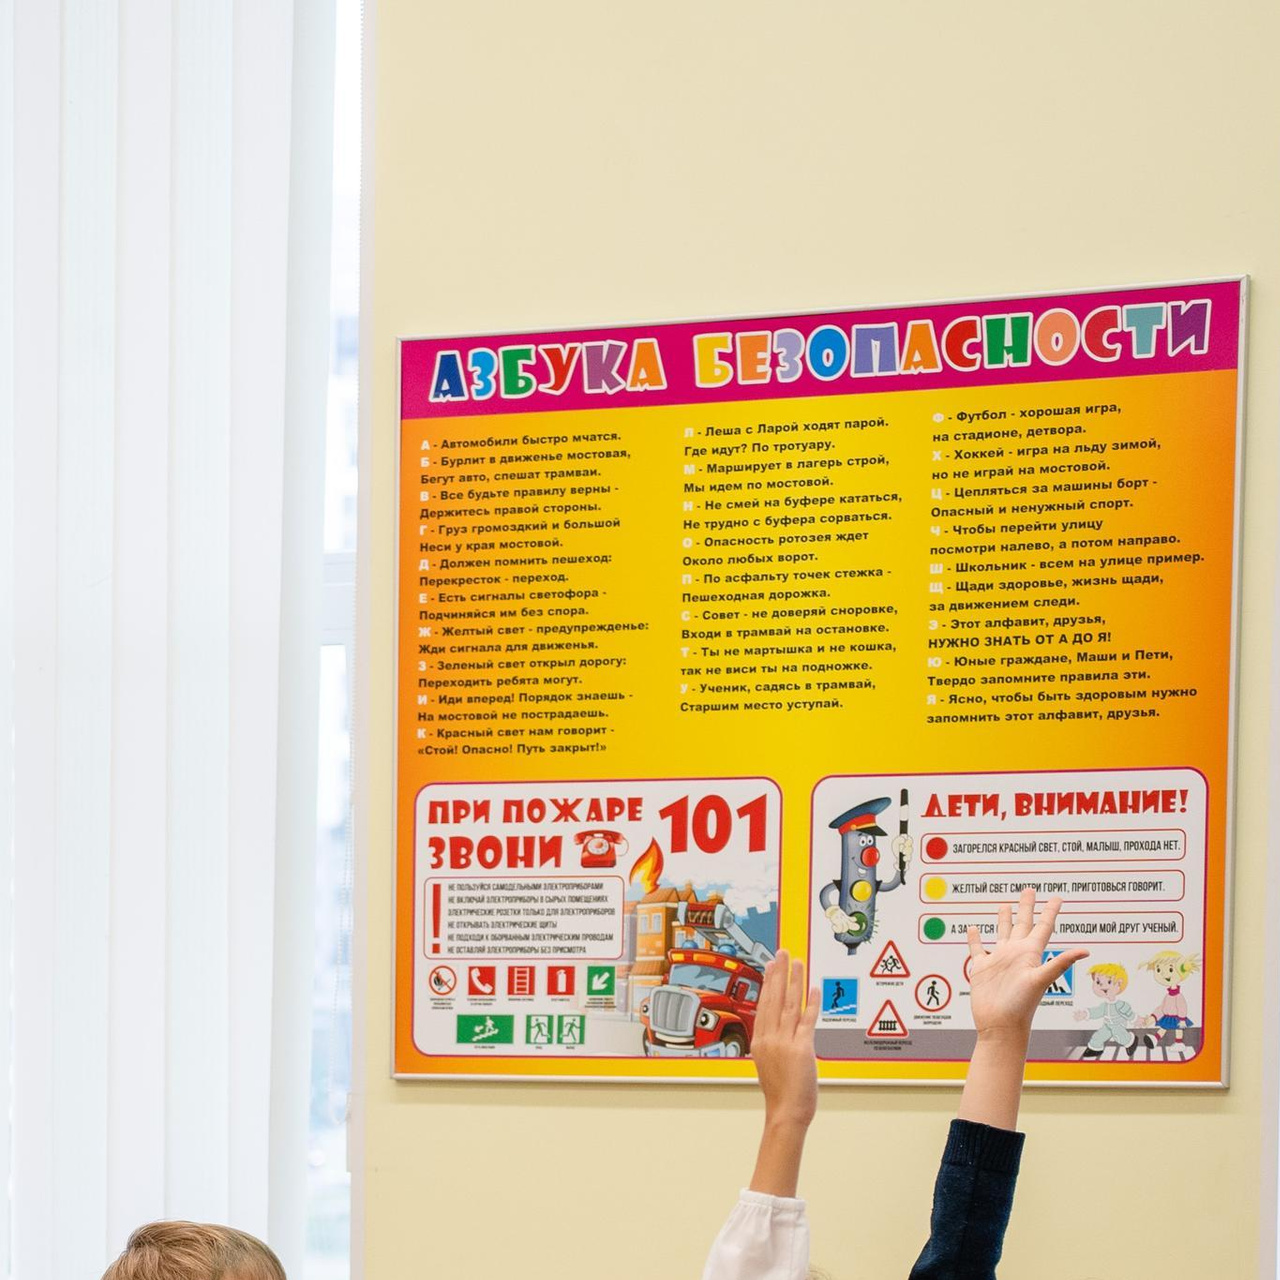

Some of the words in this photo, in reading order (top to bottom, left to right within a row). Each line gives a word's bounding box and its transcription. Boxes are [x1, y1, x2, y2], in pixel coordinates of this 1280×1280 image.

[429, 338, 667, 401] АЗБУКА
[694, 299, 1213, 387] БЕЗОПАСНОСТИ
[932, 433, 949, 442] на
[953, 429, 1022, 441] стадионе,
[1025, 425, 1086, 438] детвора.
[684, 445, 707, 457] Где
[711, 442, 747, 456] идут?
[751, 442, 769, 452] По
[772, 440, 835, 453] тротуару.
[420, 474, 455, 485] Бегут
[458, 473, 490, 482] авто,
[493, 471, 541, 481] спешат
[543, 468, 601, 480] трамваи.
[931, 471, 948, 480] но
[952, 470, 969, 478] не
[973, 465, 1013, 479] играй
[1018, 466, 1035, 475] на
[1039, 460, 1110, 474] мостовой.
[683, 482, 704, 492] Мы
[709, 482, 742, 492] идем
[746, 481, 762, 490] по
[766, 475, 833, 489] мостовой.
[419, 508, 490, 520] Держитесь
[494, 503, 539, 517] правой
[542, 503, 601, 514] стороны.
[930, 504, 994, 517] Опасный
[998, 506, 1006, 514] и
[1011, 499, 1085, 515] ненужный
[1089, 499, 1133, 510] спорт.
[683, 519, 700, 529] Не
[704, 519, 749, 531] трудно
[752, 518, 760, 526] с
[764, 515, 815, 528] буфера
[819, 512, 892, 525] сорваться.
[419, 542, 451, 552] Неси
[455, 543, 462, 553] у
[465, 541, 495, 552] края
[499, 537, 563, 549] мостовой.
[929, 544, 996, 555] посмотри
[1000, 541, 1054, 552] налево,
[1058, 540, 1067, 549] а
[1071, 538, 1113, 548] потом
[1117, 535, 1180, 547] направо.
[682, 556, 723, 566] Около
[727, 553, 773, 564] любых
[777, 553, 818, 564] ворот.
[682, 592, 765, 602] Пешеходная
[768, 589, 830, 601] дорожка.
[929, 603, 945, 611] за
[948, 599, 1029, 612] движением
[1033, 597, 1080, 608] следи.
[419, 609, 495, 621] Подчиняйся
[499, 609, 517, 617] им
[520, 606, 543, 617] без
[547, 607, 589, 617] спора.
[681, 629, 721, 640] Входи
[725, 629, 733, 637] в
[736, 625, 791, 639] трамвай
[795, 627, 811, 635] на
[815, 624, 889, 635] остановке.
[928, 636, 980, 648] НУЖНО
[984, 634, 1030, 647] ЗНАТЬ
[1034, 633, 1054, 645] ОТ
[1058, 633, 1068, 644] А
[1071, 632, 1093, 645] ДО
[1097, 631, 1111, 642] Я!
[418, 644, 446, 655] Жди
[449, 644, 502, 653] сигнала
[504, 643, 528, 652] для
[531, 641, 598, 652] движенья.
[680, 667, 701, 675] так
[705, 666, 721, 675] не
[725, 665, 757, 674] виси
[760, 665, 777, 673] ты
[781, 664, 798, 672] на
[801, 662, 872, 673] подножке.
[418, 677, 492, 689] Переходить
[496, 675, 539, 688] ребята
[543, 676, 582, 686] могут.
[926, 675, 976, 688] Твердо
[980, 674, 1056, 684] запомните
[1059, 671, 1118, 684] правила
[1122, 670, 1150, 680] эти.
[679, 701, 739, 714] Старшим
[743, 701, 783, 710] место
[786, 697, 843, 712] уступай.
[417, 711, 434, 721] На
[437, 710, 498, 721] мостовой
[501, 711, 517, 720] не
[520, 709, 609, 721] пострадаешь.
[926, 713, 1000, 723] запомнить
[1004, 712, 1034, 721] этот
[1037, 709, 1102, 722] алфавит,
[1106, 708, 1159, 720] друзья.
[417, 744, 458, 755] «Стой!
[461, 743, 513, 754] Опасно!
[516, 743, 546, 755] Путь
[549, 742, 607, 754] закрыт!»
[428, 799, 491, 824] ПРИ
[503, 797, 644, 822] ПОЖАРЕ
[920, 793, 1007, 821] ДЕТИ,
[1014, 789, 1189, 816] ВНИМАНИЕ!
[659, 793, 768, 854] 101
[428, 835, 563, 869] ЗВОНИ
[952, 842, 997, 854] ЗАГОРЕЛСЯ
[998, 840, 1037, 853] КРАСНЫЙ
[1038, 841, 1060, 852] СВЕТ,
[1061, 839, 1084, 852] СТОЙ,
[1085, 841, 1122, 852] МАЛЫШ,
[1123, 840, 1162, 851] ПРОХОДА
[1162, 839, 1181, 852] НЕТ.
[951, 881, 987, 893] ЖЕЛТЫЙ
[988, 882, 1008, 893] СВЕТ
[1042, 881, 1070, 893] ГОРИТ,
[1071, 881, 1126, 892] ПРИГОТОВЬСЯ
[1127, 880, 1165, 892] ГОВОРИТ.
[951, 924, 956, 934] А
[957, 923, 995, 934] ЗАЕГСЯ
[1059, 922, 1097, 934] ПРОХОДИ
[1098, 921, 1116, 933] МОЙ
[1117, 922, 1140, 934] ДРУГ
[1141, 921, 1180, 935] УЧЕНЫЙ.
